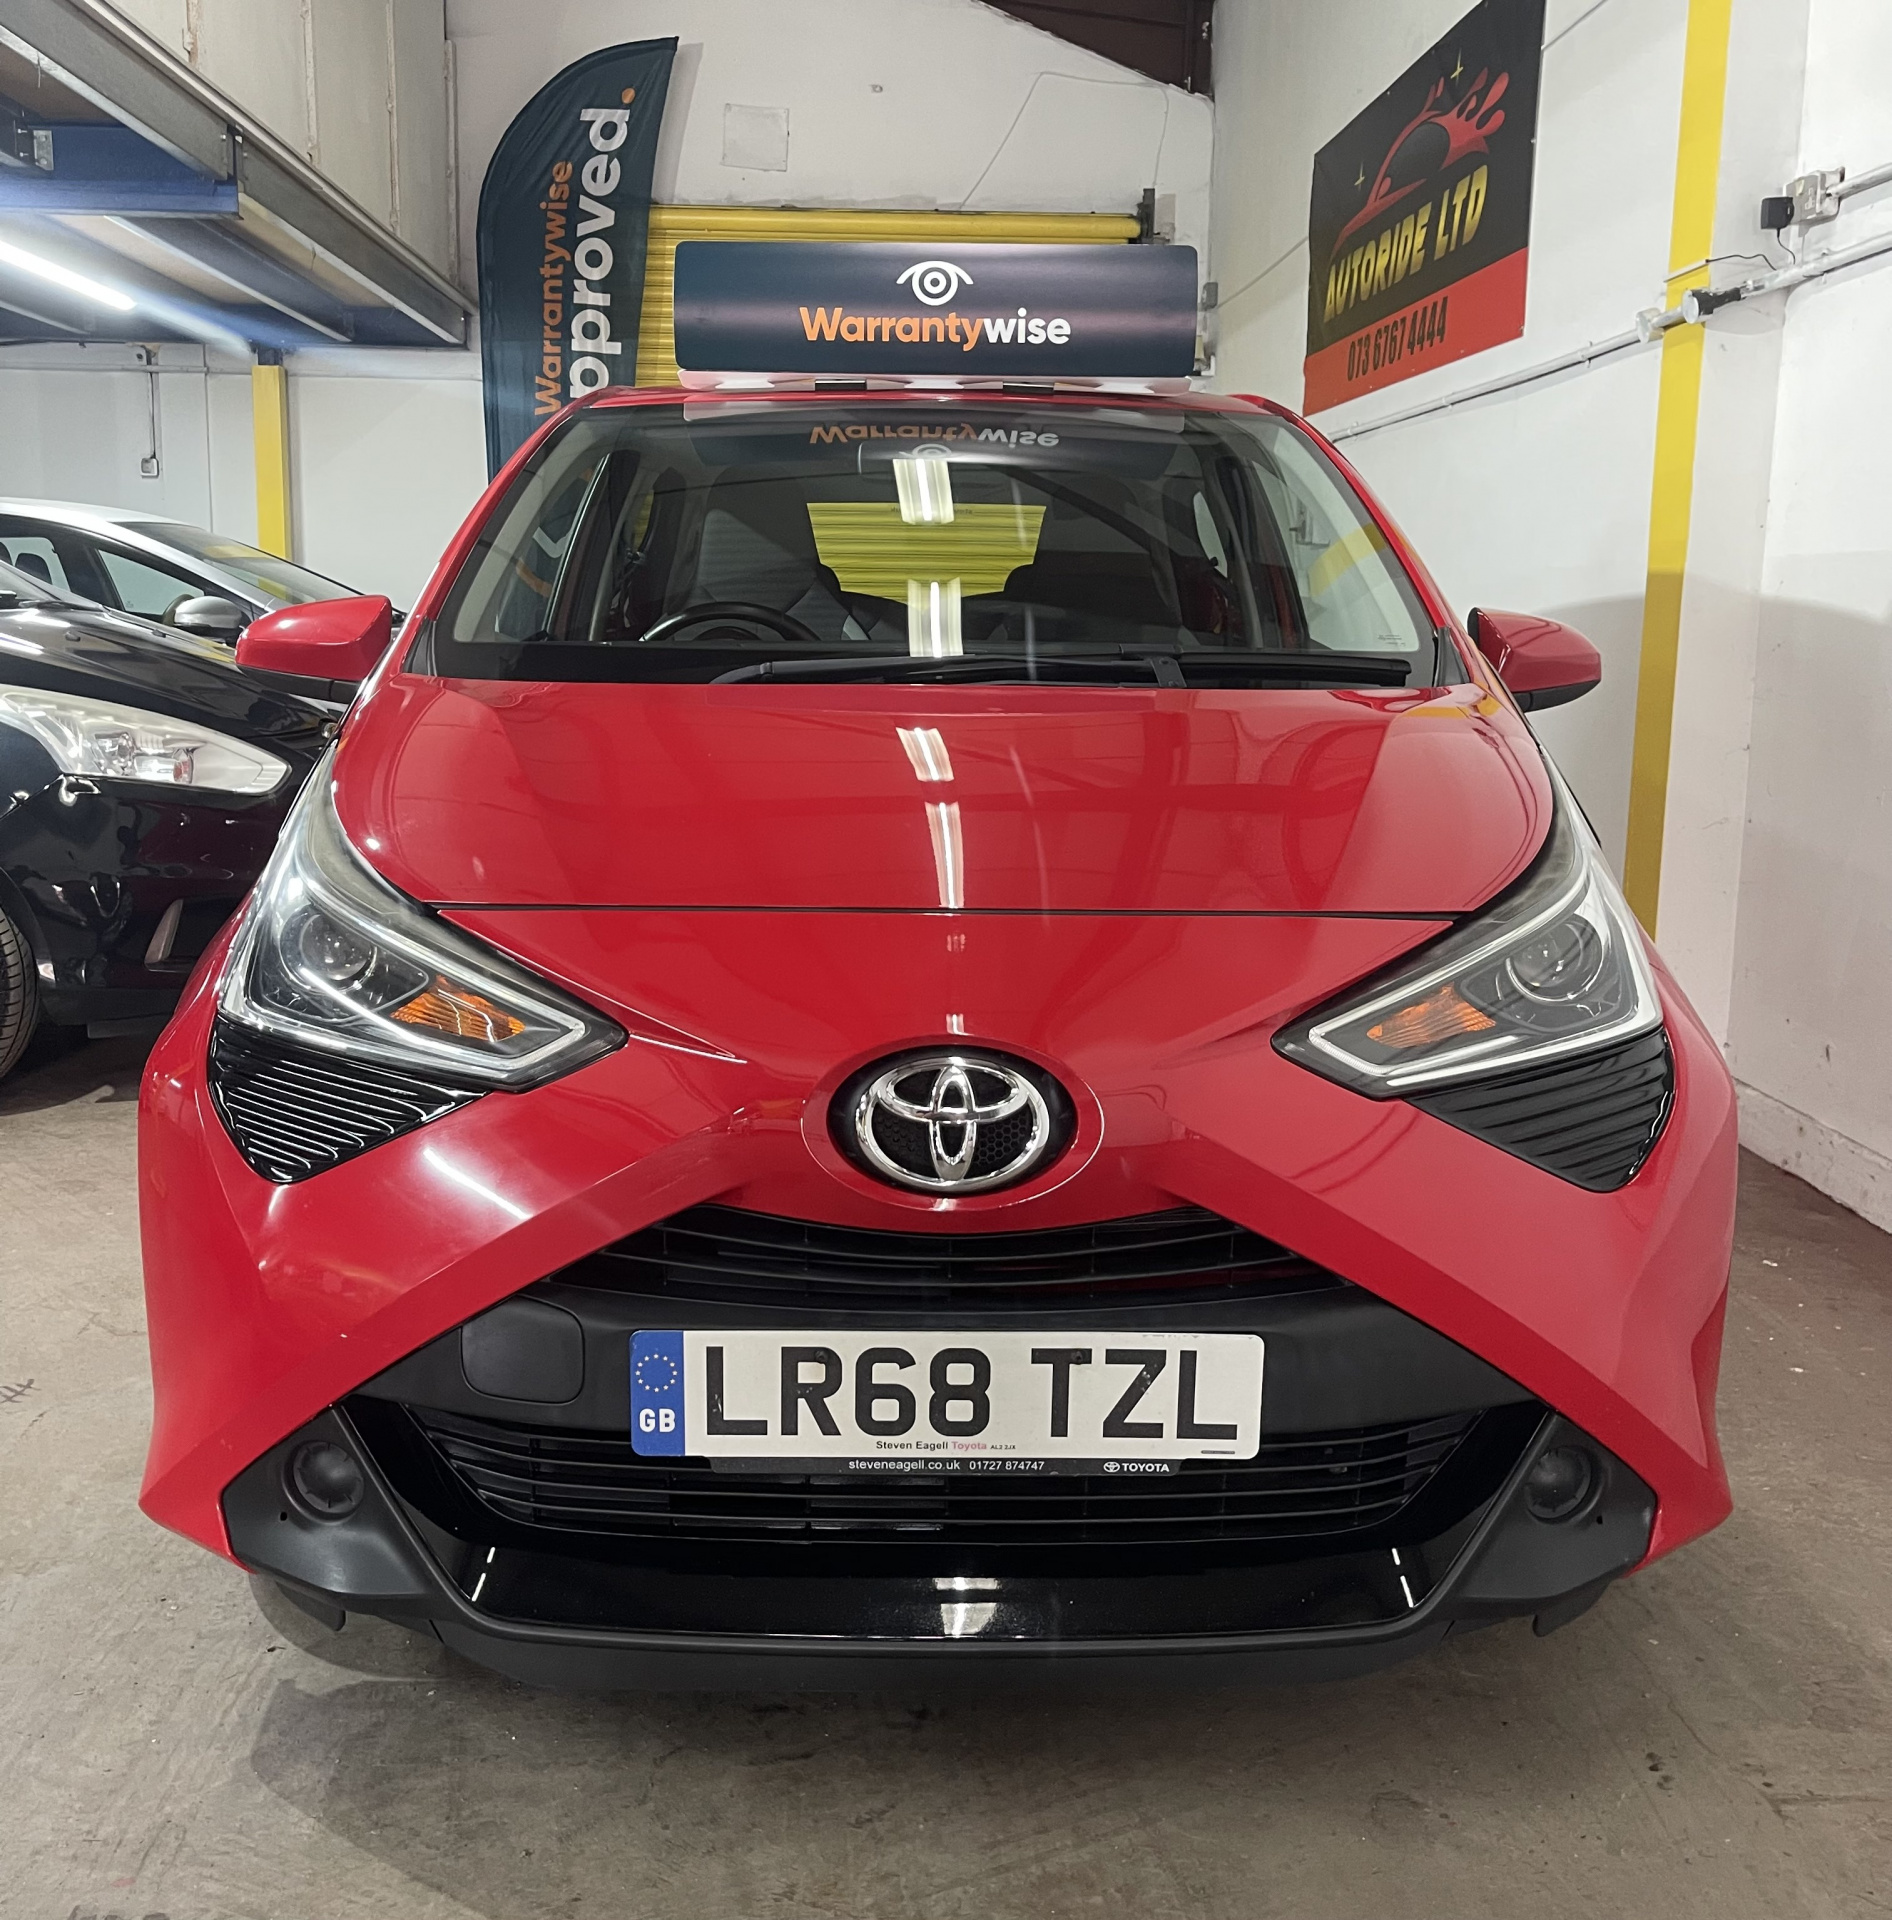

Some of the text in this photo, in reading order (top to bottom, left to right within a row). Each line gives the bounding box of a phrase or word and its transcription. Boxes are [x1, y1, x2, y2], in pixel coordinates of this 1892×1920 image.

[569, 87, 636, 399] pproved.
[1323, 164, 1489, 323] AUTORIDE LTD
[535, 160, 574, 416] Warrantywise
[799, 306, 1072, 352] Warrantywise
[1347, 296, 1449, 382] 073 6767 4444
[638, 1408, 676, 1434] GB
[705, 1345, 1239, 1441] LR68 TZL
[848, 1459, 1170, 1473] steveneagell.co.uk 01727 874747 TOYOTA
[876, 1440, 913, 1450] Steven
[915, 1440, 949, 1451] Eagell
[951, 1440, 988, 1452] Toyota
